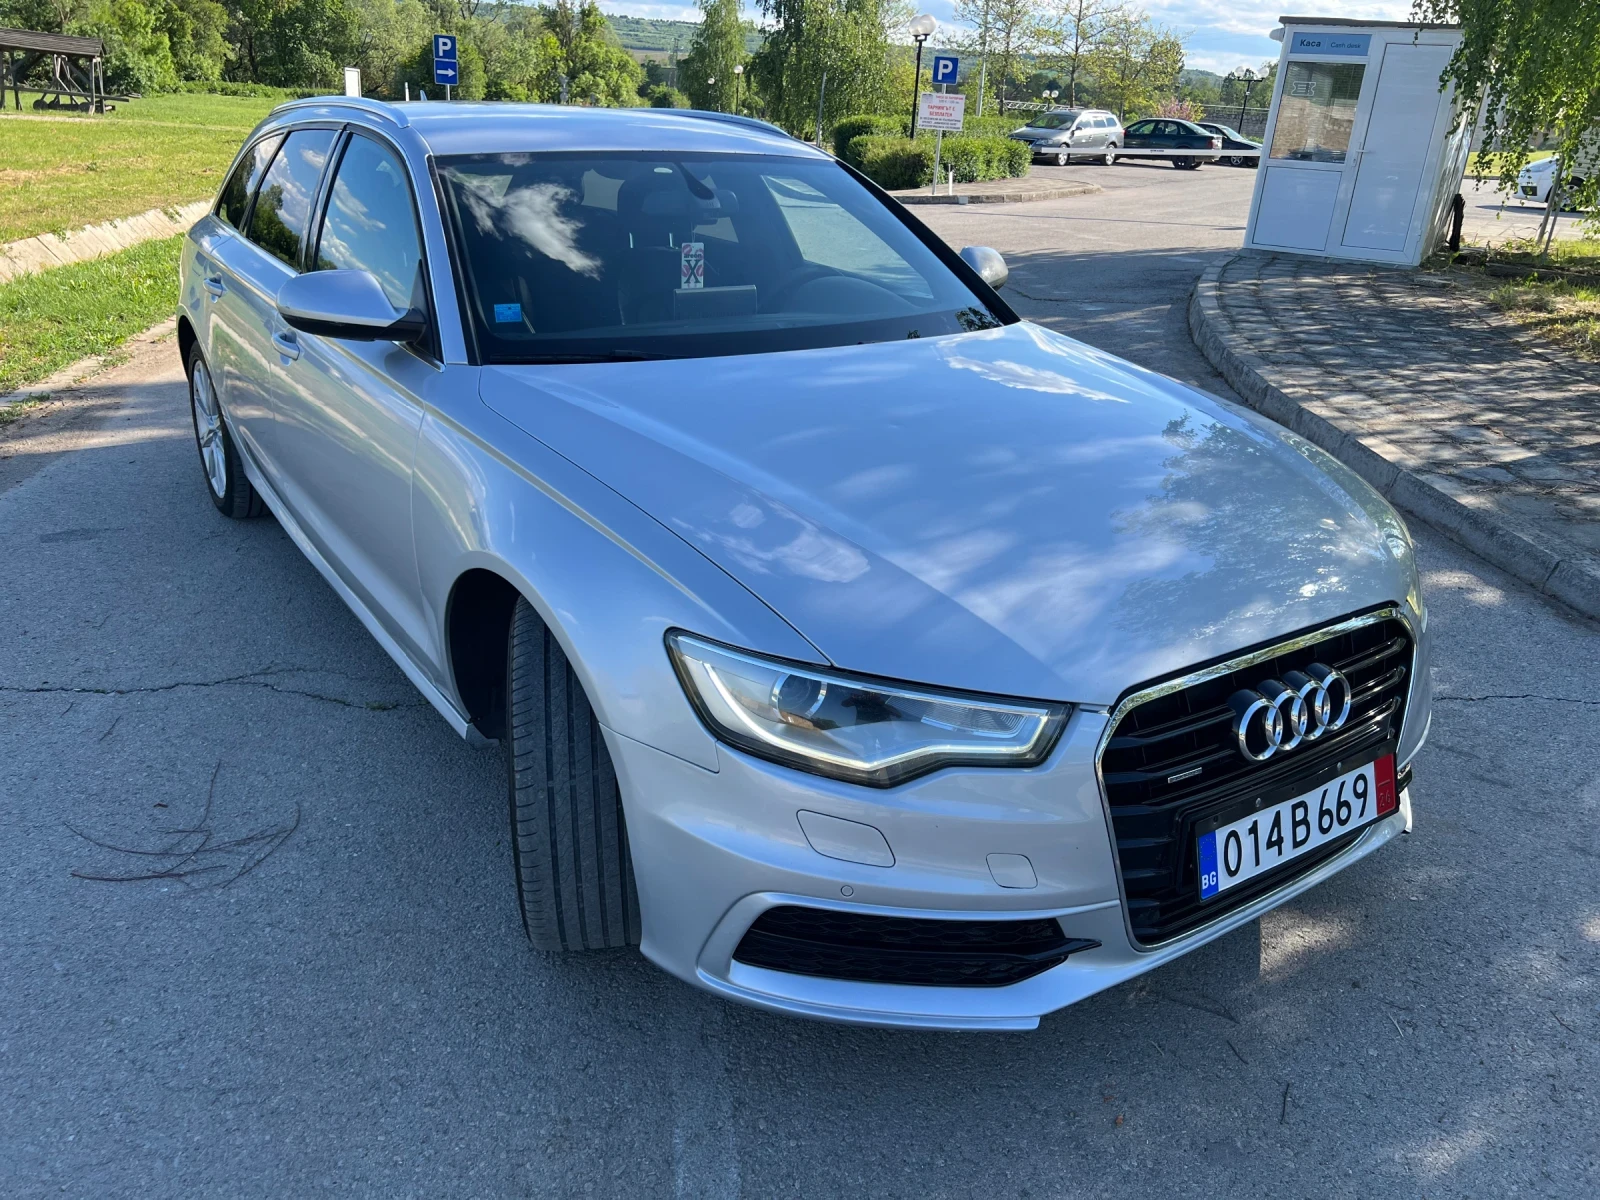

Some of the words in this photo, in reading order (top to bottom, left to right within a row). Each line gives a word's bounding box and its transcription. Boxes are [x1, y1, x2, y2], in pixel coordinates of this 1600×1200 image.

[438, 37, 452, 57] P
[1299, 39, 1321, 48] Каса
[937, 59, 953, 81] P
[1223, 773, 1368, 878] 014B669
[1201, 871, 1217, 890] BG
